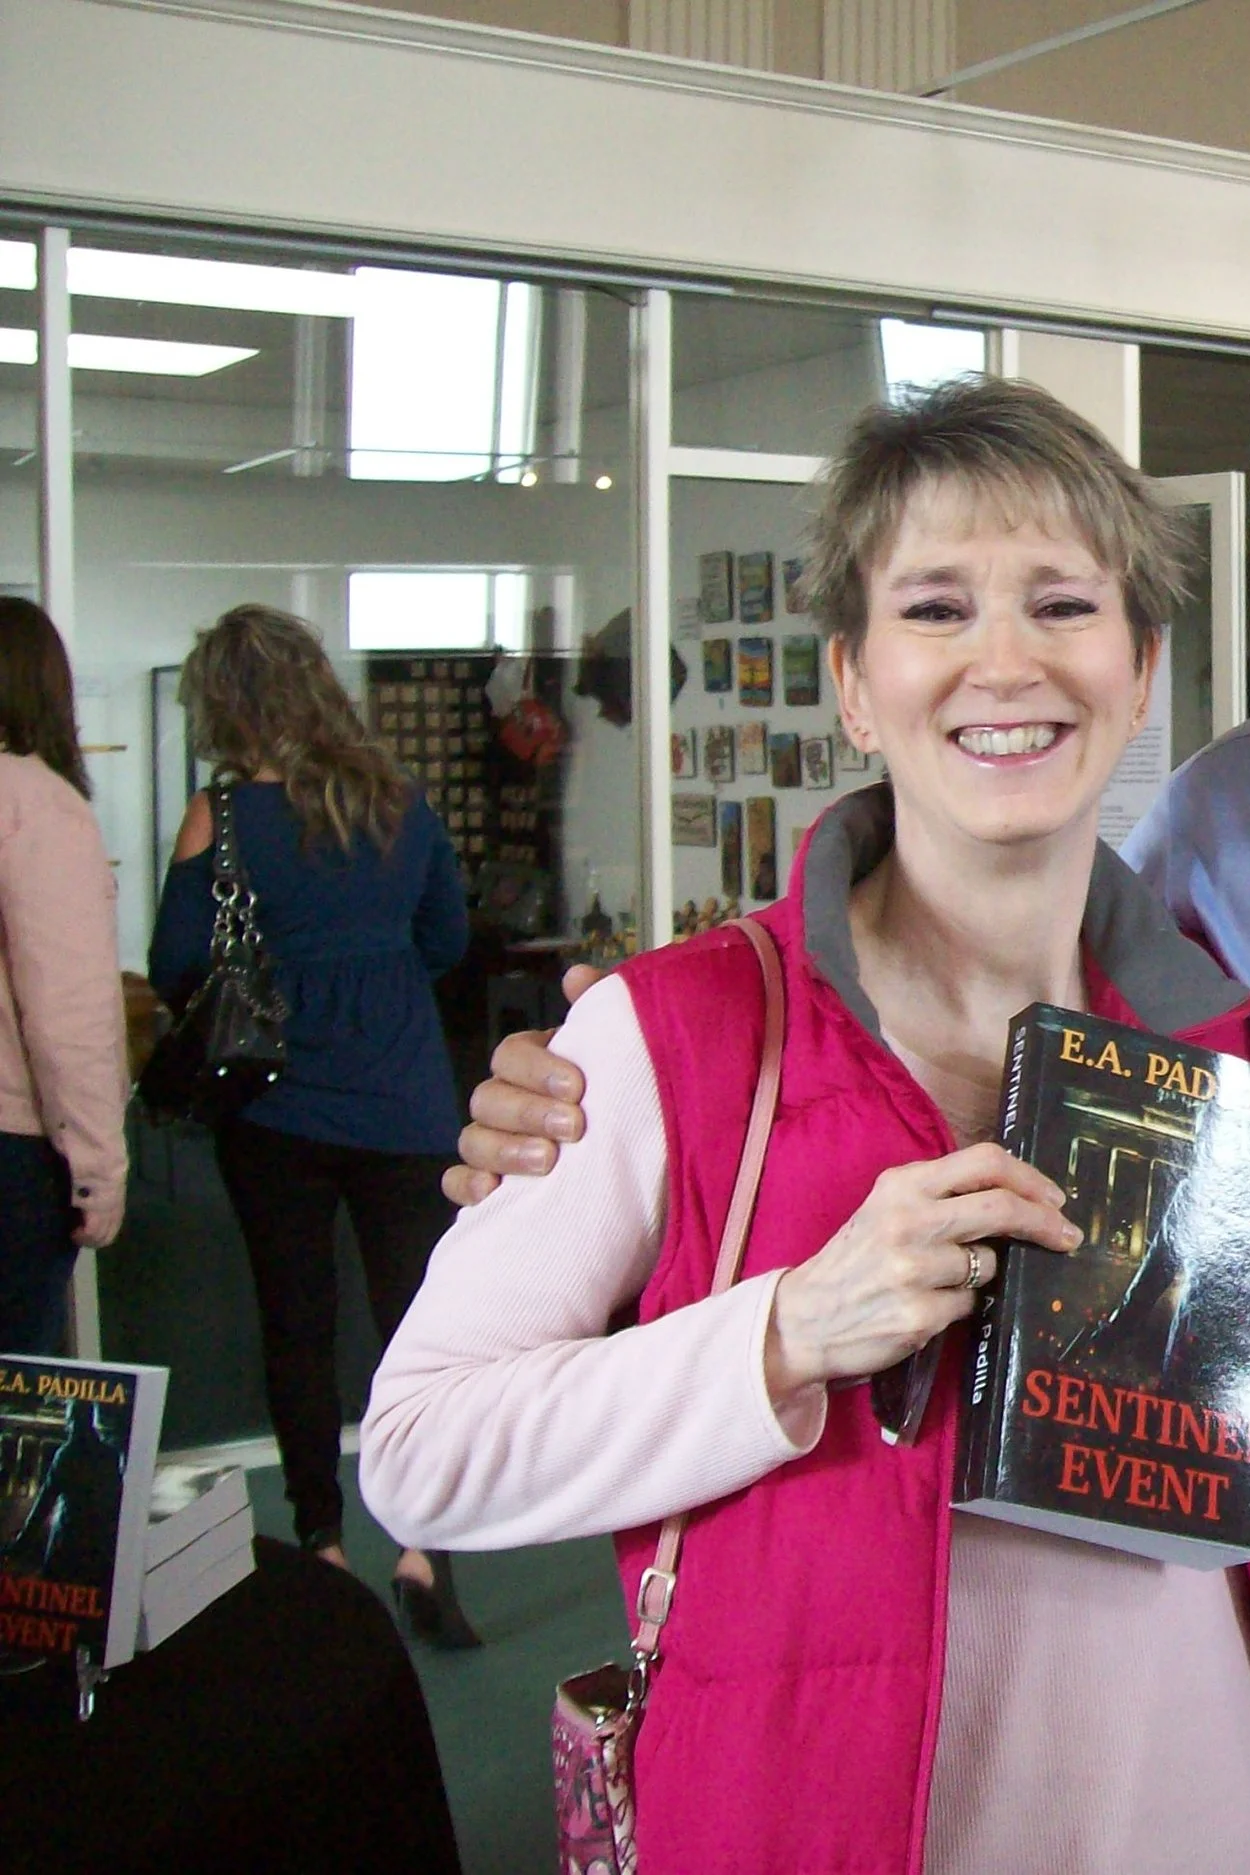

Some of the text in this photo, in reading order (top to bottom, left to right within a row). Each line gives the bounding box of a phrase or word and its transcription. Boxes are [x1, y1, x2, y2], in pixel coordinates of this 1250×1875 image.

[1003, 1026, 1026, 1140] SENTINEL
[1060, 1028, 1132, 1077] E.A.
[37, 1374, 126, 1405] PADILLA
[972, 1323, 992, 1406] Padilla
[1056, 1442, 1230, 1520] EVENT
